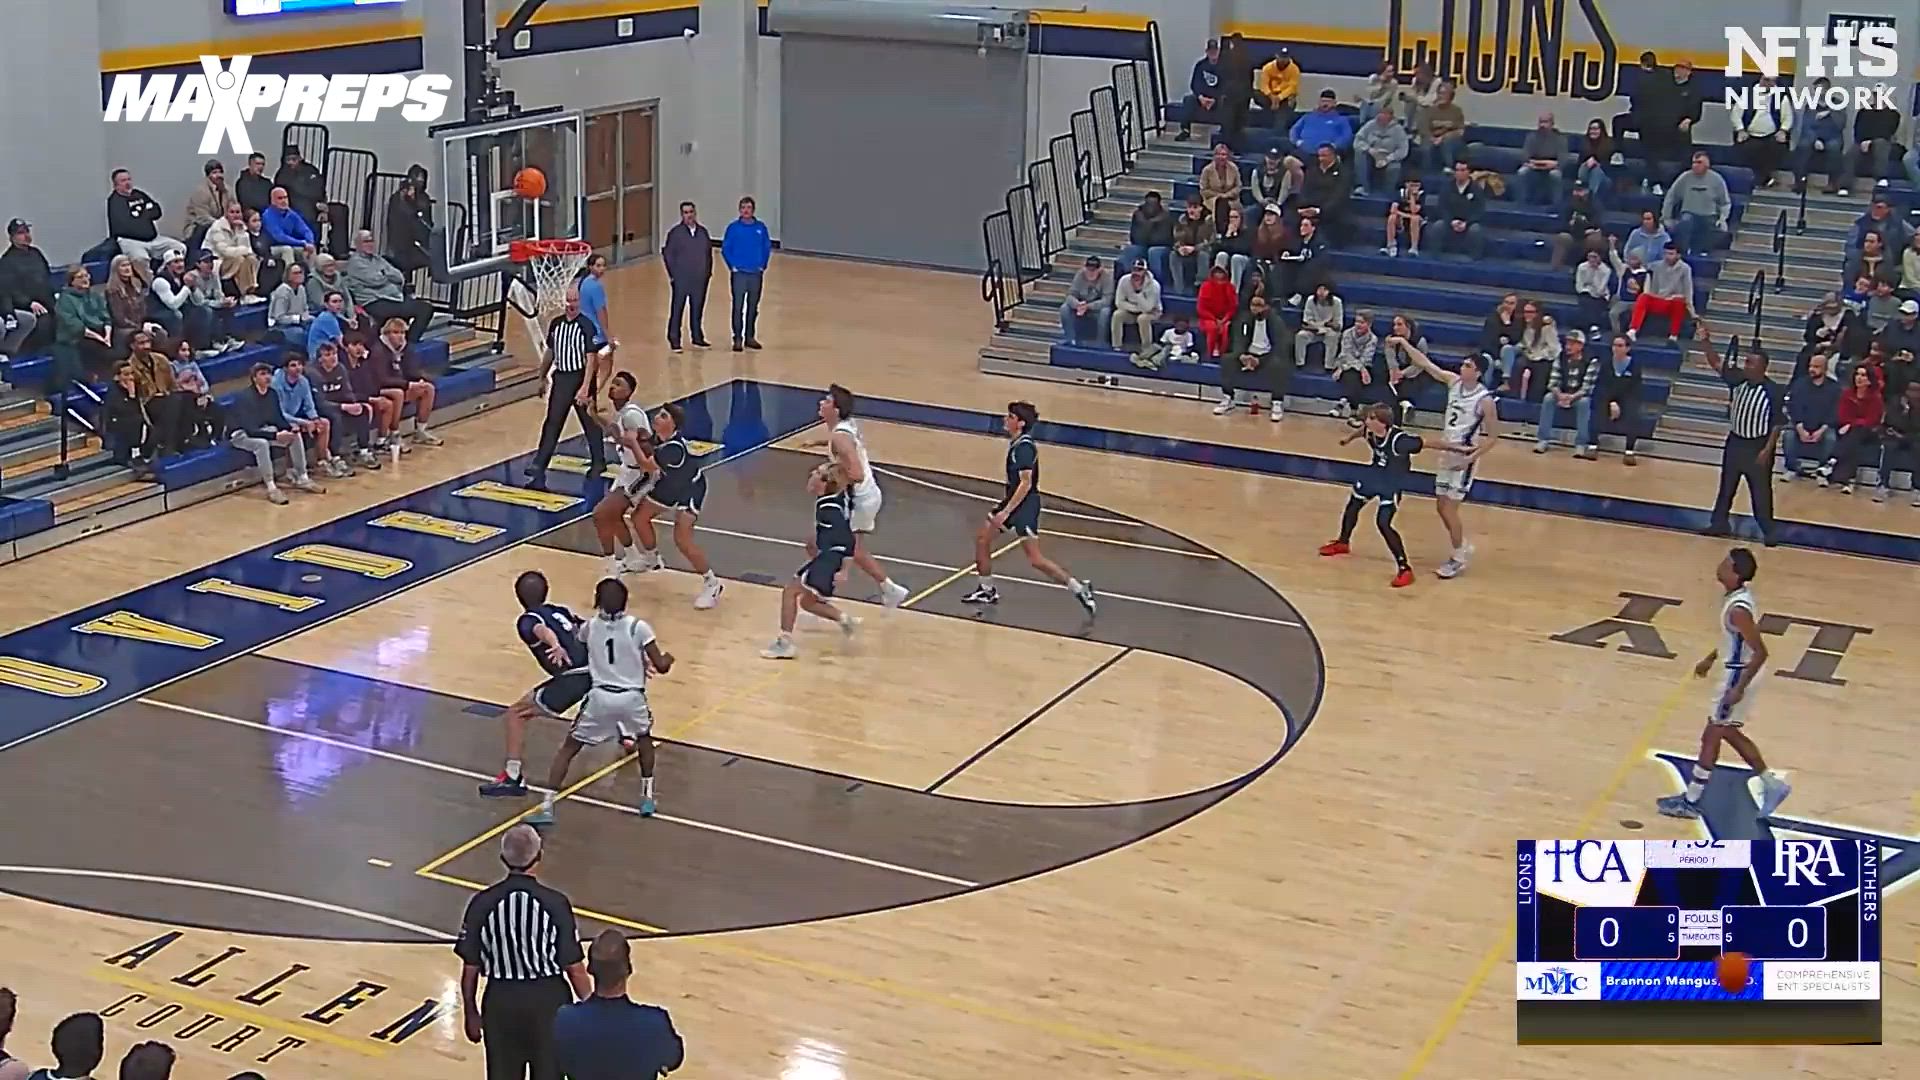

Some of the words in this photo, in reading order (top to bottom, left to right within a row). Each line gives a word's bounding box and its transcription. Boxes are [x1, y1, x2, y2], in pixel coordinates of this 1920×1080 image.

[1449, 411, 1458, 426] 2
[551, 611, 573, 632] 3
[605, 638, 614, 664] 1
[104, 931, 446, 1045] ALLEN
[102, 995, 304, 1063] COURT
